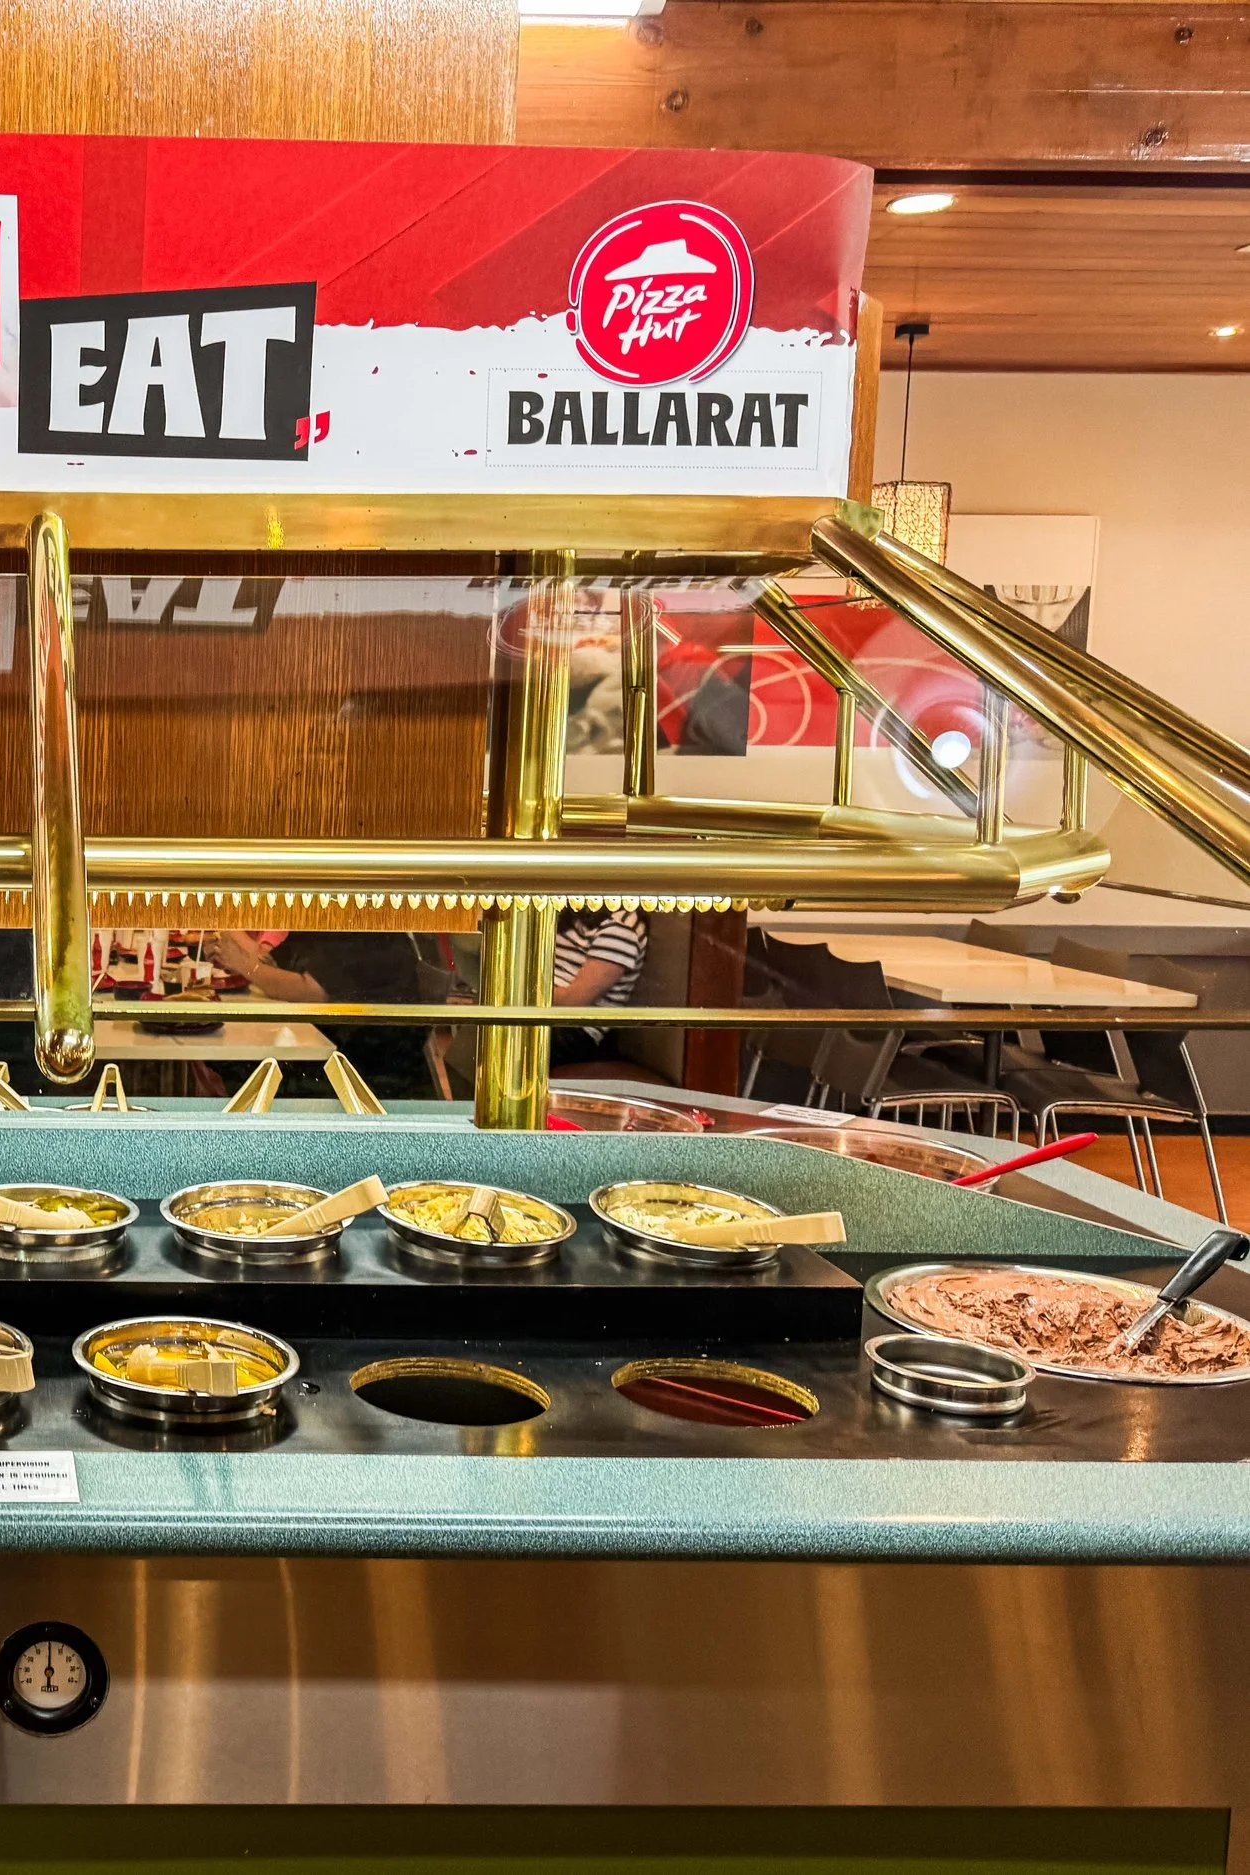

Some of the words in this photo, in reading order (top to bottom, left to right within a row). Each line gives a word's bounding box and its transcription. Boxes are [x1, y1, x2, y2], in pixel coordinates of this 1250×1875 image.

[602, 276, 708, 329] Pizza
[618, 308, 702, 355] Hut
[507, 390, 809, 448] BALLARAT
